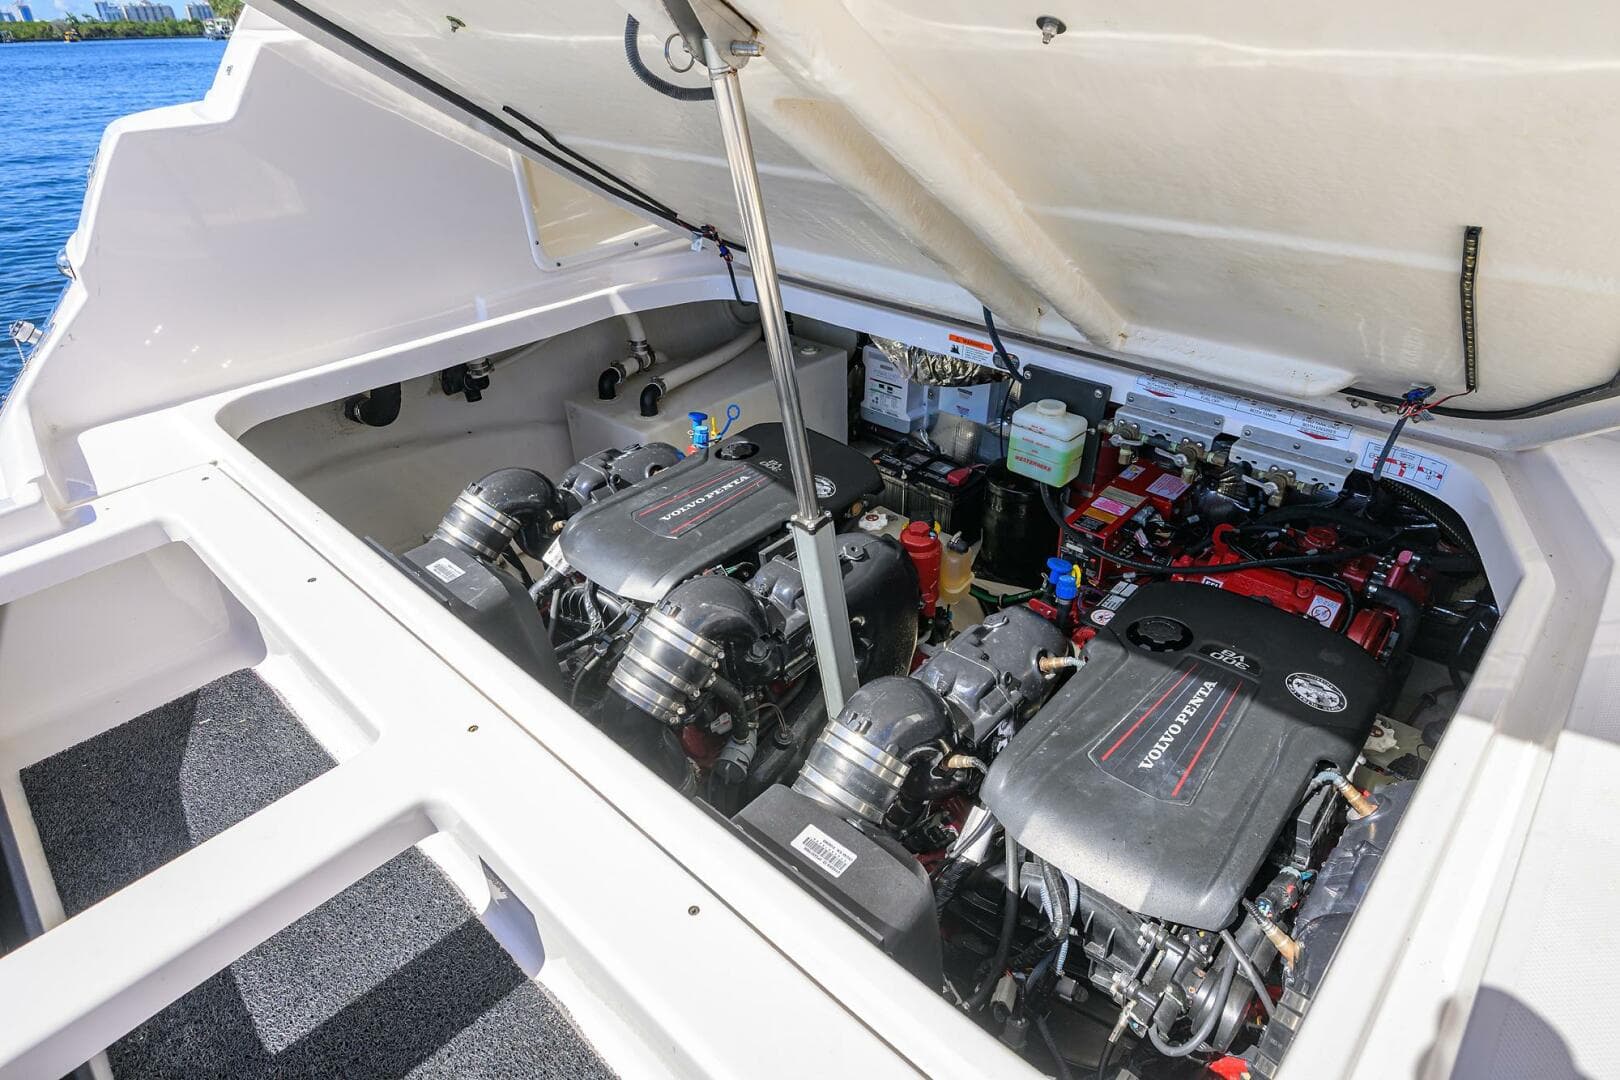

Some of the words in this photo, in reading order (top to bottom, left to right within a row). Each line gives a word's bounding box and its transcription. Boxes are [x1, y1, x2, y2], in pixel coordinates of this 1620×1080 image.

[659, 497, 705, 520] VOLVO
[704, 476, 751, 499] PENTA
[1210, 652, 1250, 670] 300
[1220, 649, 1245, 663] V8
[1138, 723, 1182, 769] VOLVO
[1175, 681, 1218, 726] PENTA
